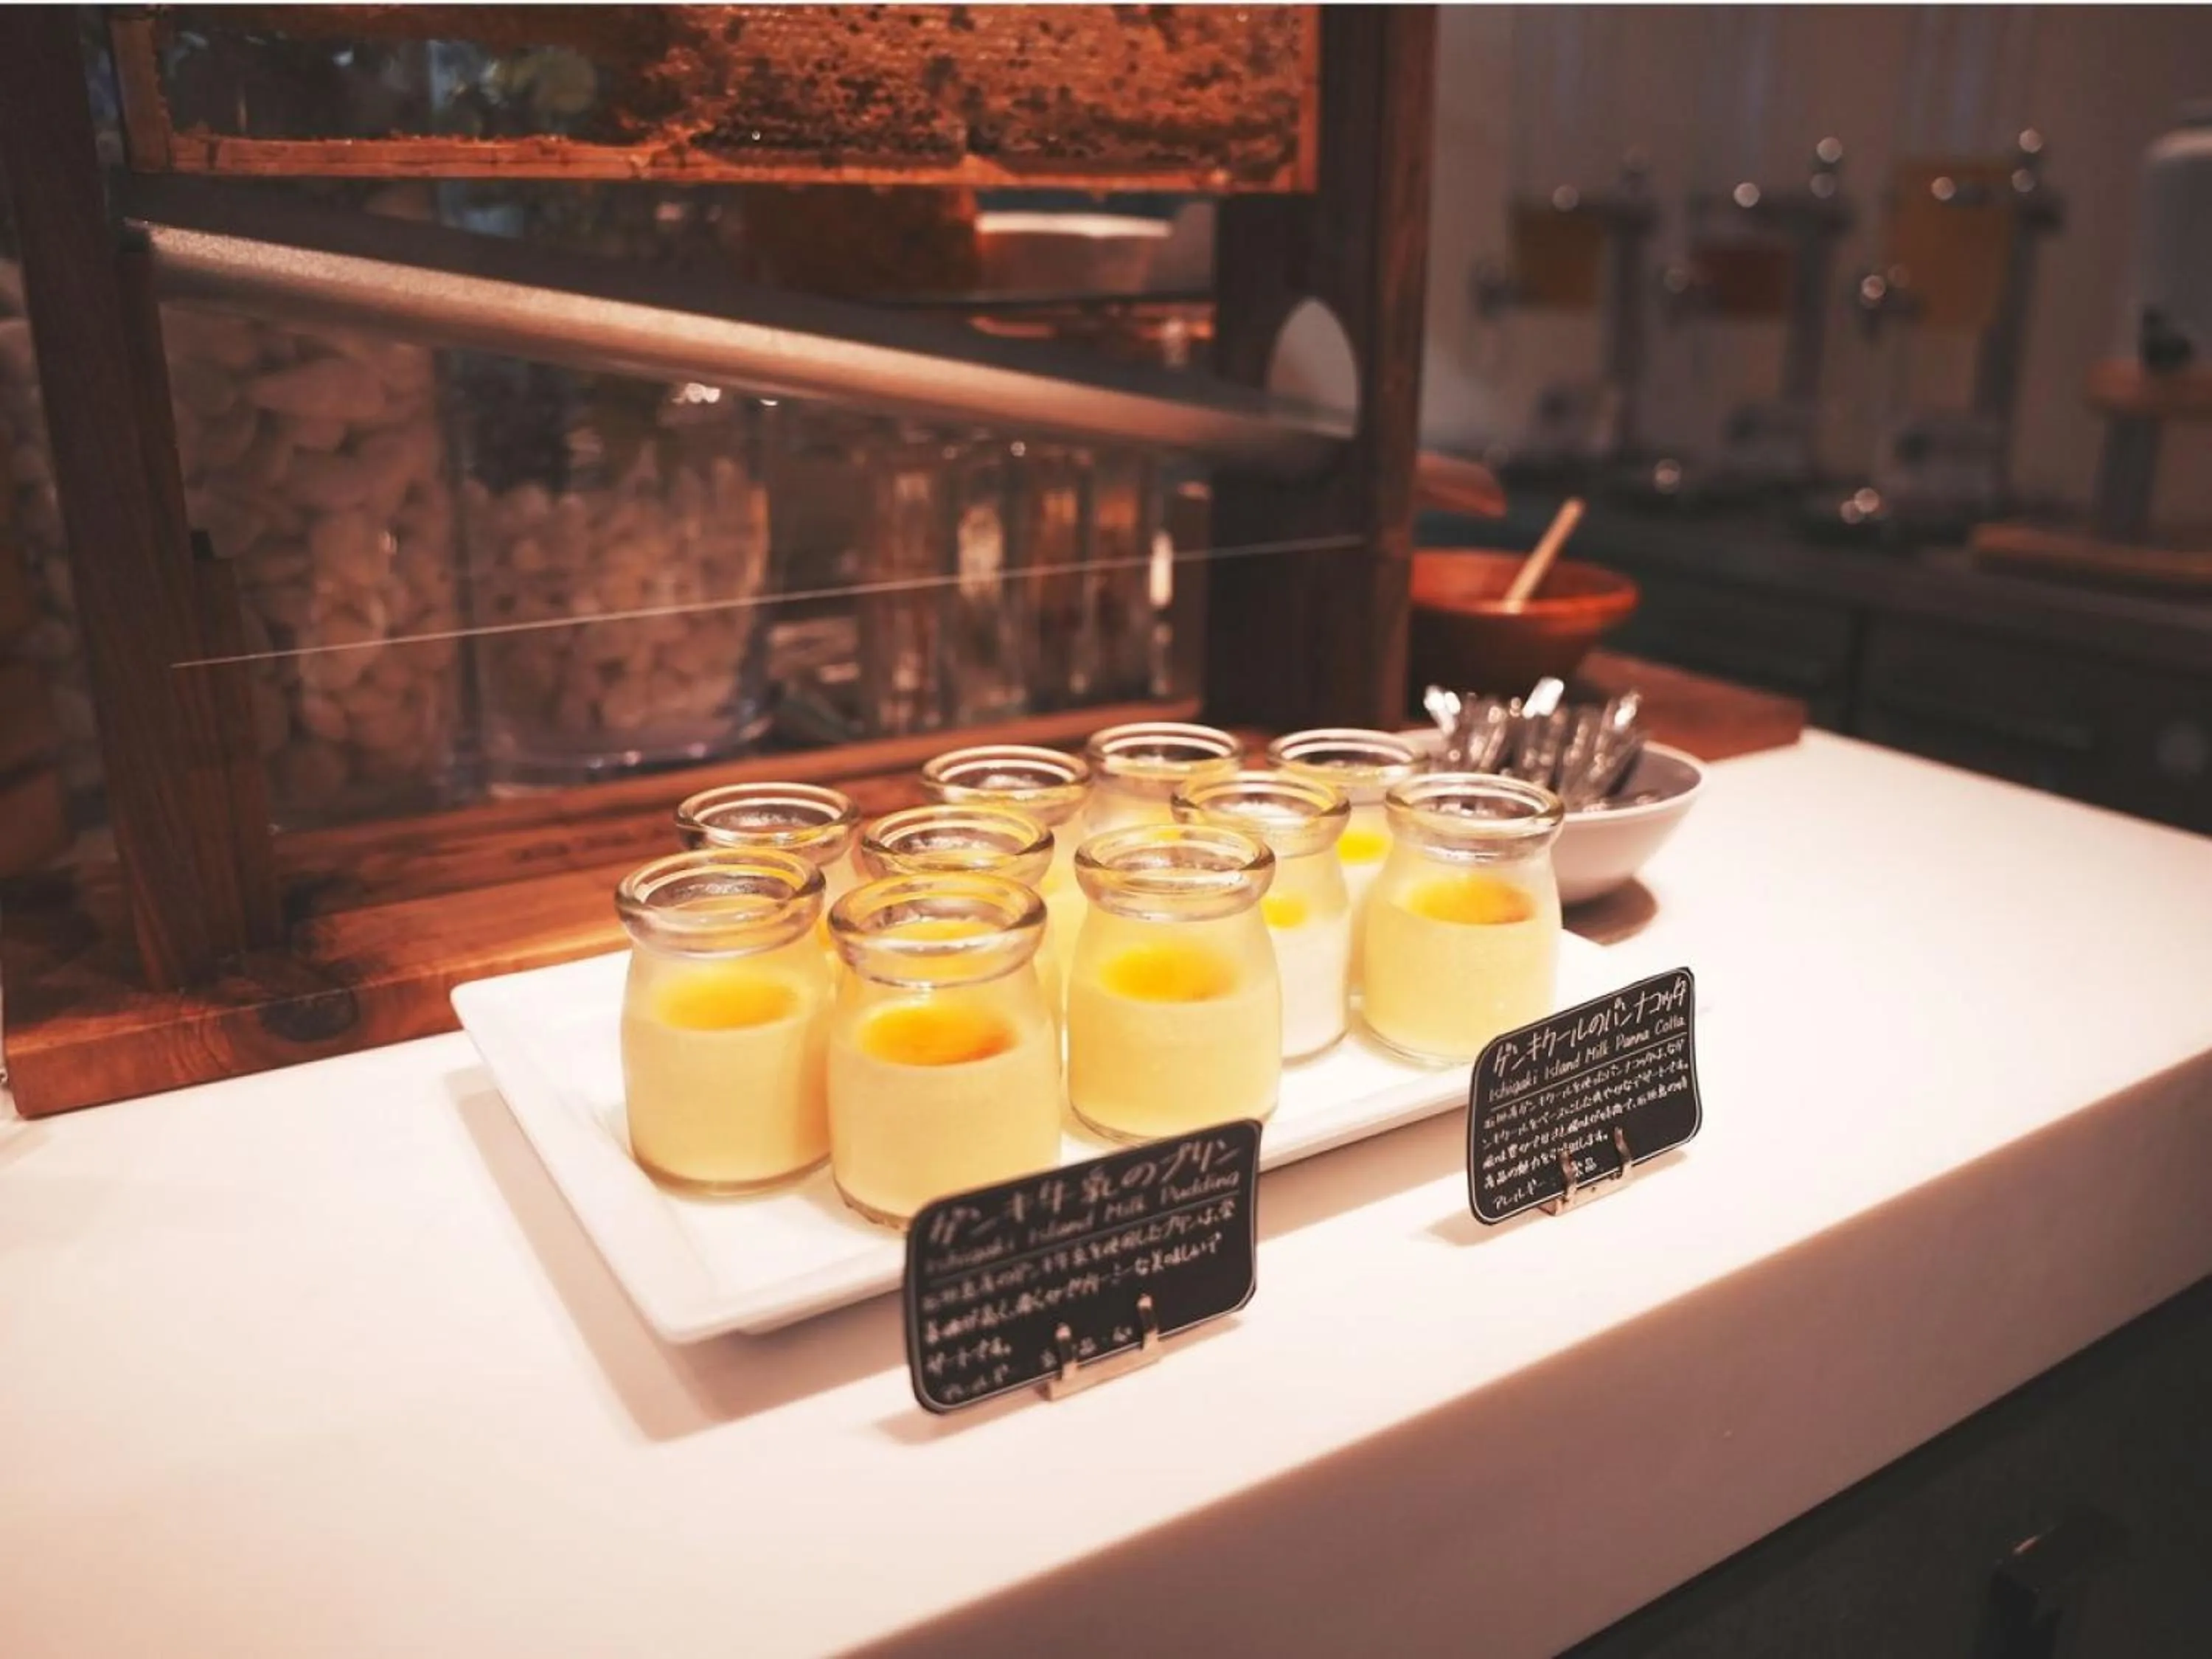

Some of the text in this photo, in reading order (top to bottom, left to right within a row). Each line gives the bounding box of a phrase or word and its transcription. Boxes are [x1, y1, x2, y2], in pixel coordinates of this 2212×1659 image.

[1545, 1051, 1581, 1080] Island
[1585, 1039, 1608, 1063] Milk
[1615, 1029, 1650, 1051] Panna
[1655, 1015, 1686, 1035] Cotta
[1105, 1195, 1145, 1222] Milk
[1161, 1170, 1240, 1204] Pudding
